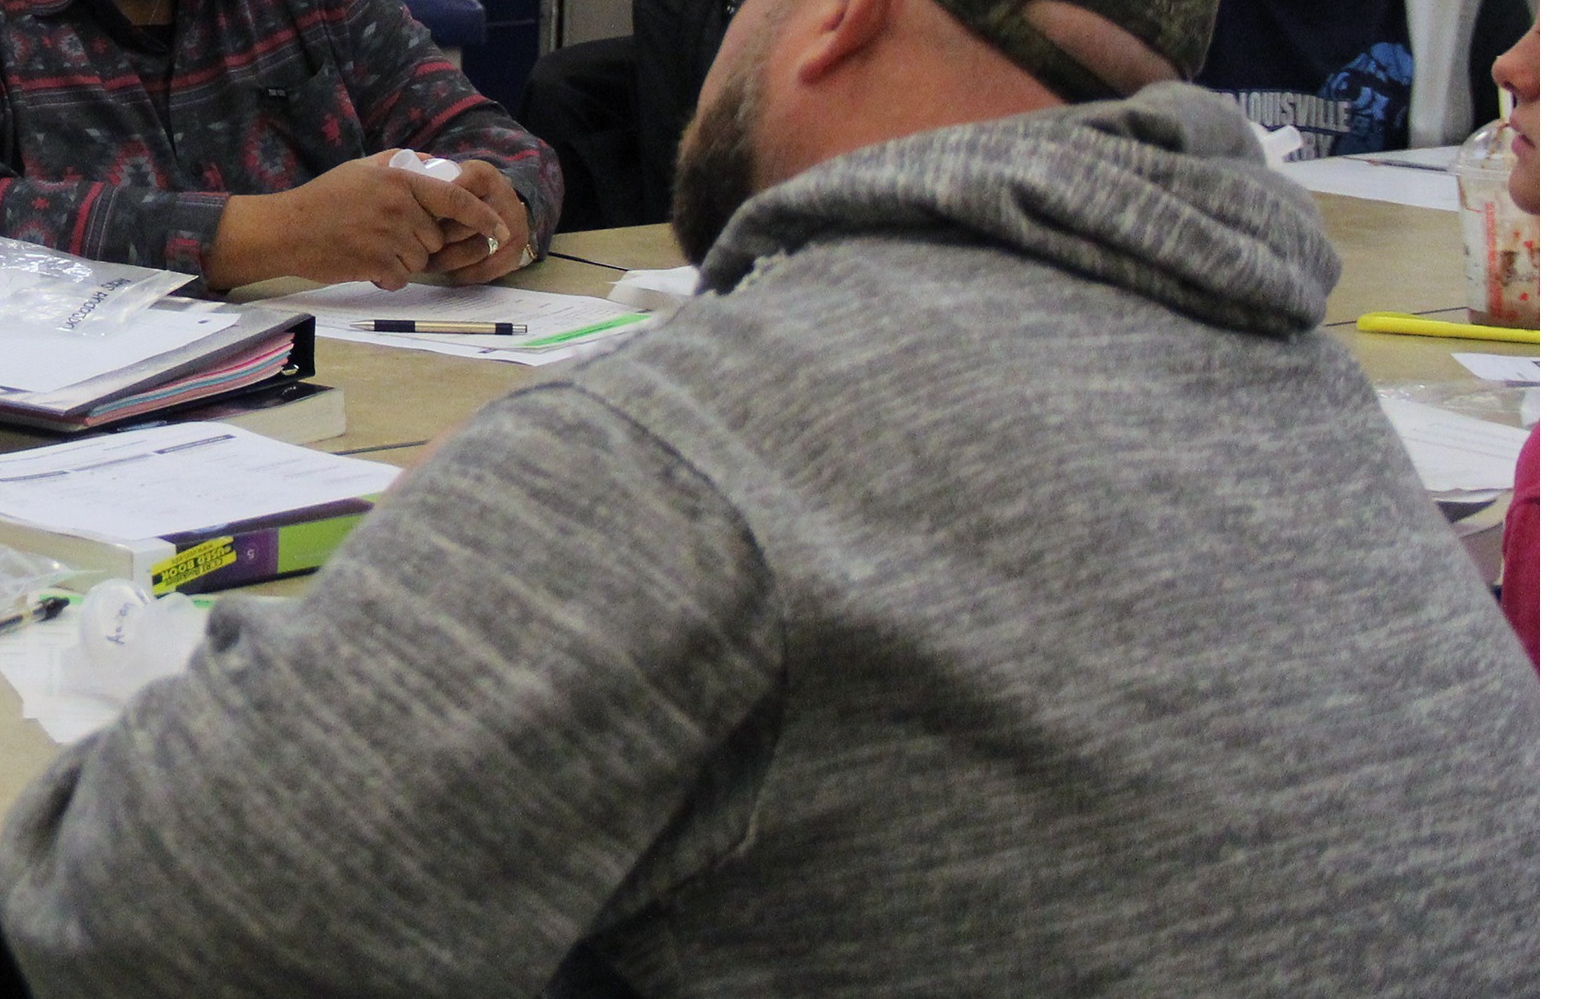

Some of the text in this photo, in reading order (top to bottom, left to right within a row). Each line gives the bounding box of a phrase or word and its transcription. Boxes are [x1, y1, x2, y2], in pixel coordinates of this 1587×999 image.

[1238, 91, 1352, 133] LOUISVILLE
[162, 547, 225, 580] USED BOOK
